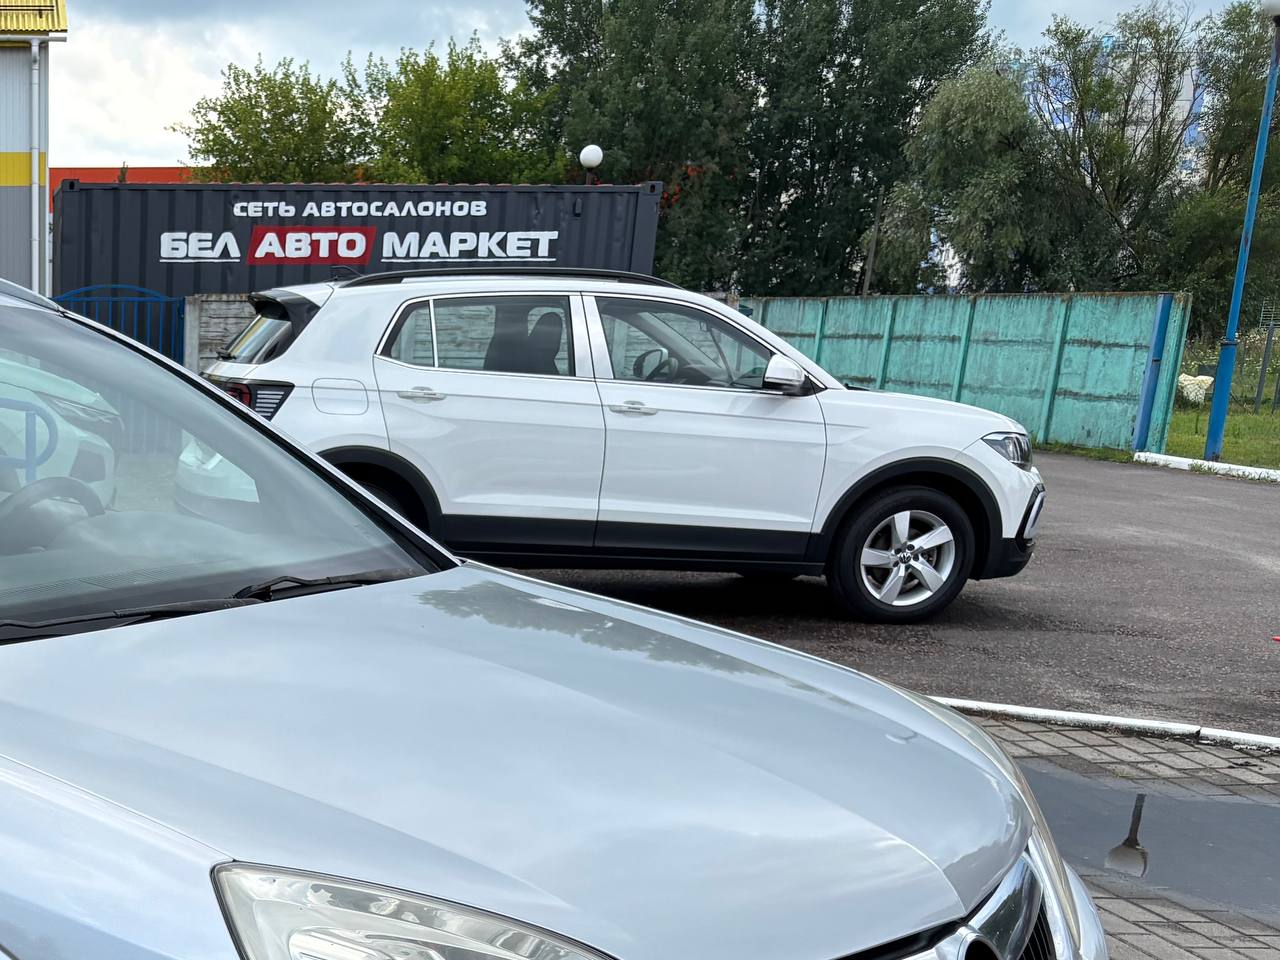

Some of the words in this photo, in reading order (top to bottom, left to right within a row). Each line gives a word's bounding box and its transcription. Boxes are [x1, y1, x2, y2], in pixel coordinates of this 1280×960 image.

[233, 201, 296, 217] СЕТЬ
[302, 200, 487, 217] АВТОСАЛОНОВ
[160, 231, 241, 258] БЕЛ
[254, 231, 367, 258] АВТО
[381, 230, 559, 258] МАРКЕТ
